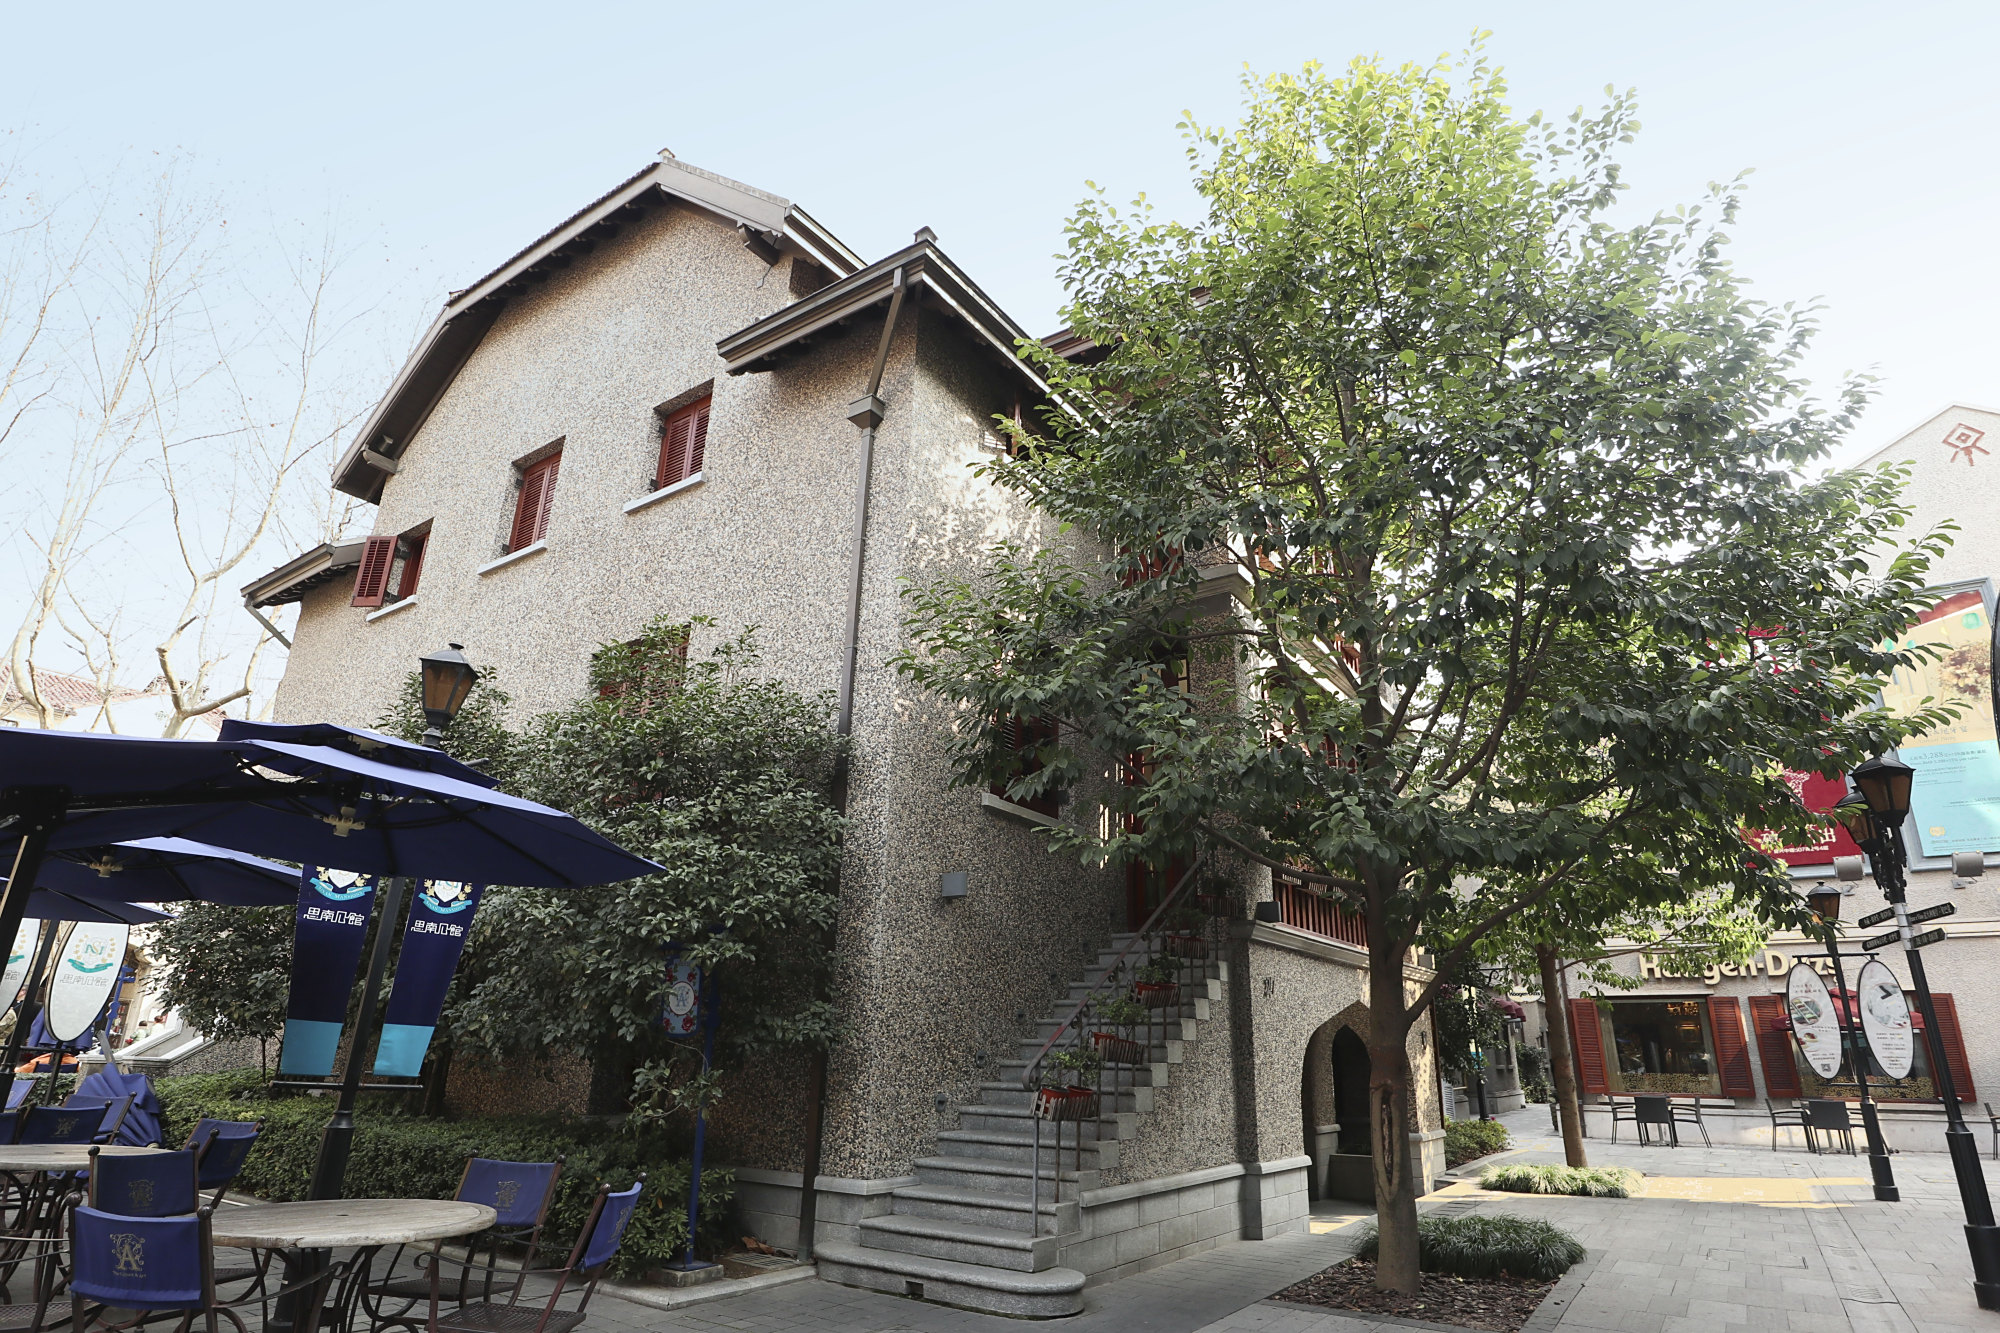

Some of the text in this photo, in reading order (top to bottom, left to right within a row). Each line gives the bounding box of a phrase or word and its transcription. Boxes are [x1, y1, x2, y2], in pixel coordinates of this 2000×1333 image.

[303, 906, 364, 926] 思南公馆
[411, 919, 464, 937] 思南公馆
[1639, 951, 1838, 985] Hgen-Dzs
